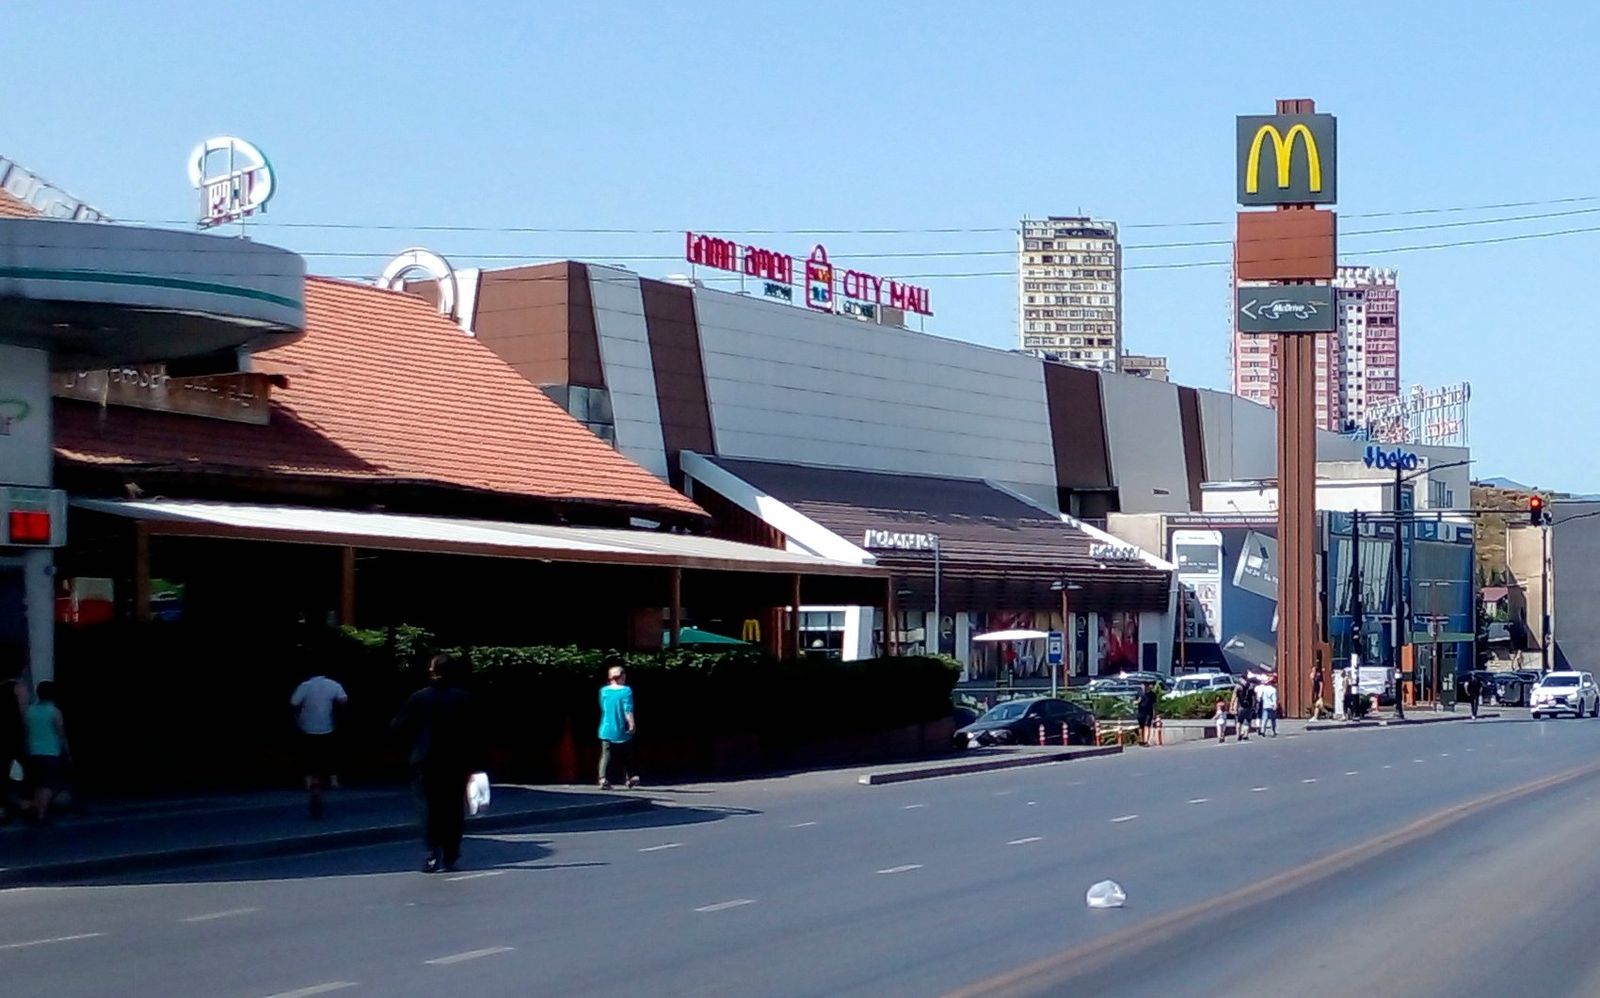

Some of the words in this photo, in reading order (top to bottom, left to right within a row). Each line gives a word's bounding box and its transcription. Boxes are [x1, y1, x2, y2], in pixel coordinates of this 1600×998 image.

[844, 269, 884, 304] CITY
[890, 281, 934, 316] MALL
[1272, 303, 1305, 313] McDrive
[1376, 446, 1418, 470] beko
